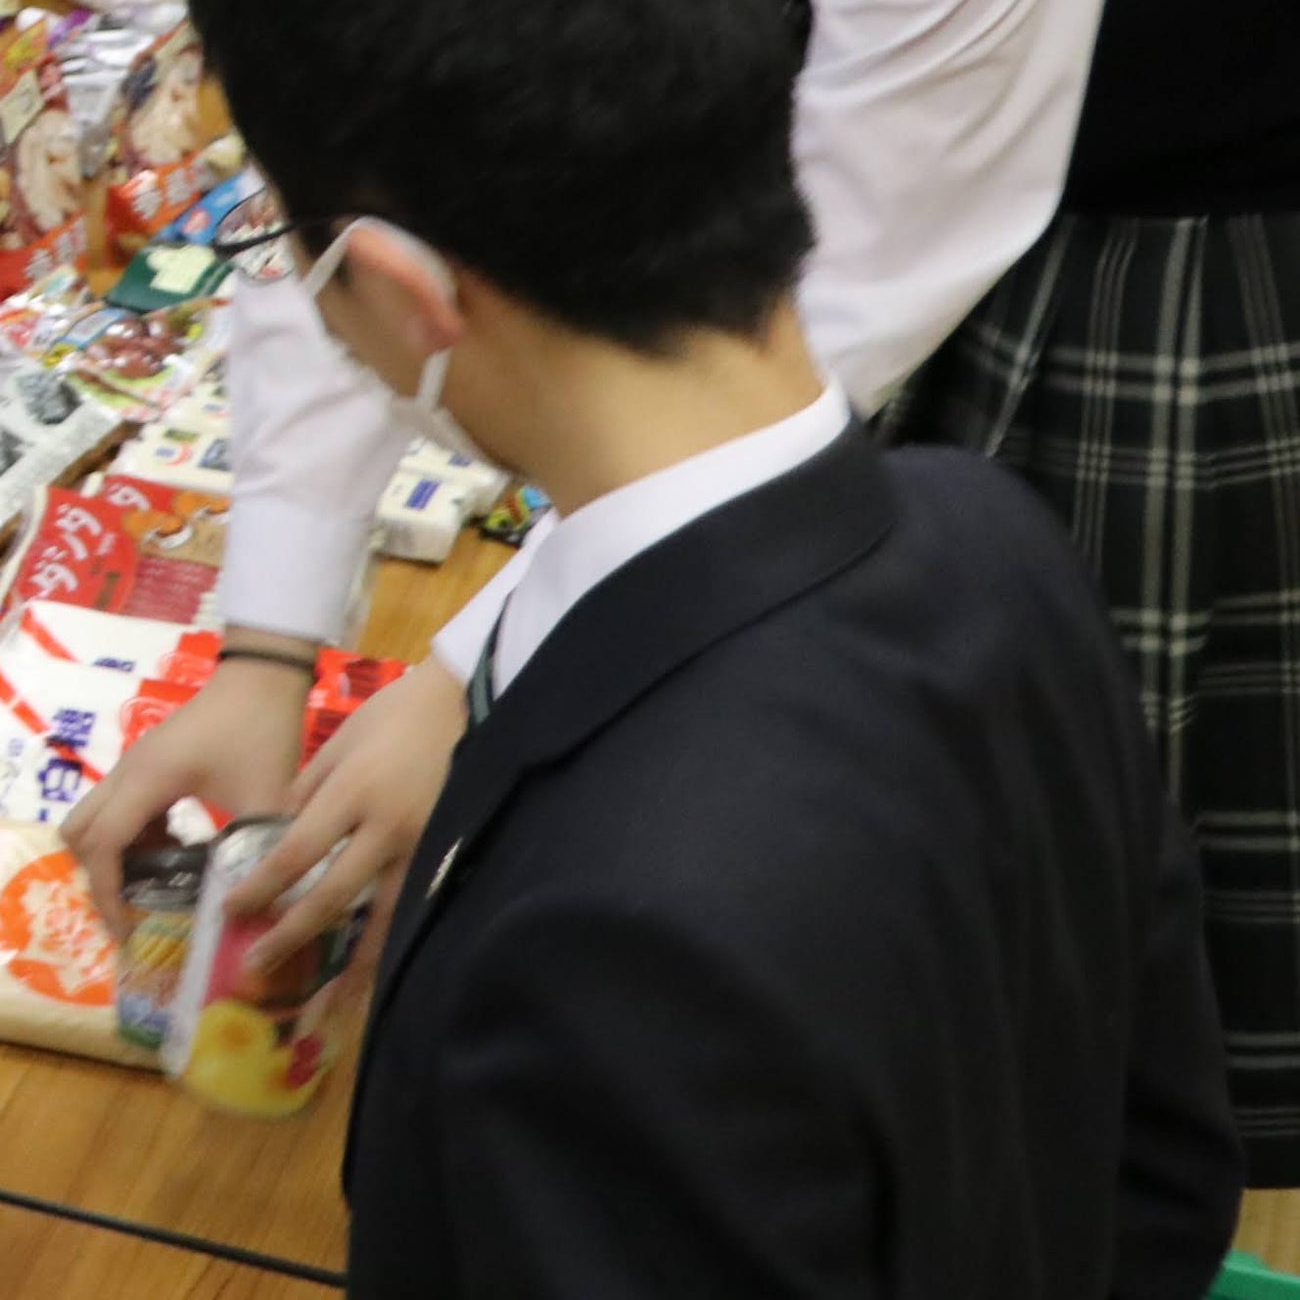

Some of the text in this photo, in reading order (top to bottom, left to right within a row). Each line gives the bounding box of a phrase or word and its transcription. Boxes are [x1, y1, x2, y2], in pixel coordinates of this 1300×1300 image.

[30, 502, 103, 593] ダシダ
[36, 706, 97, 823] 白糖
